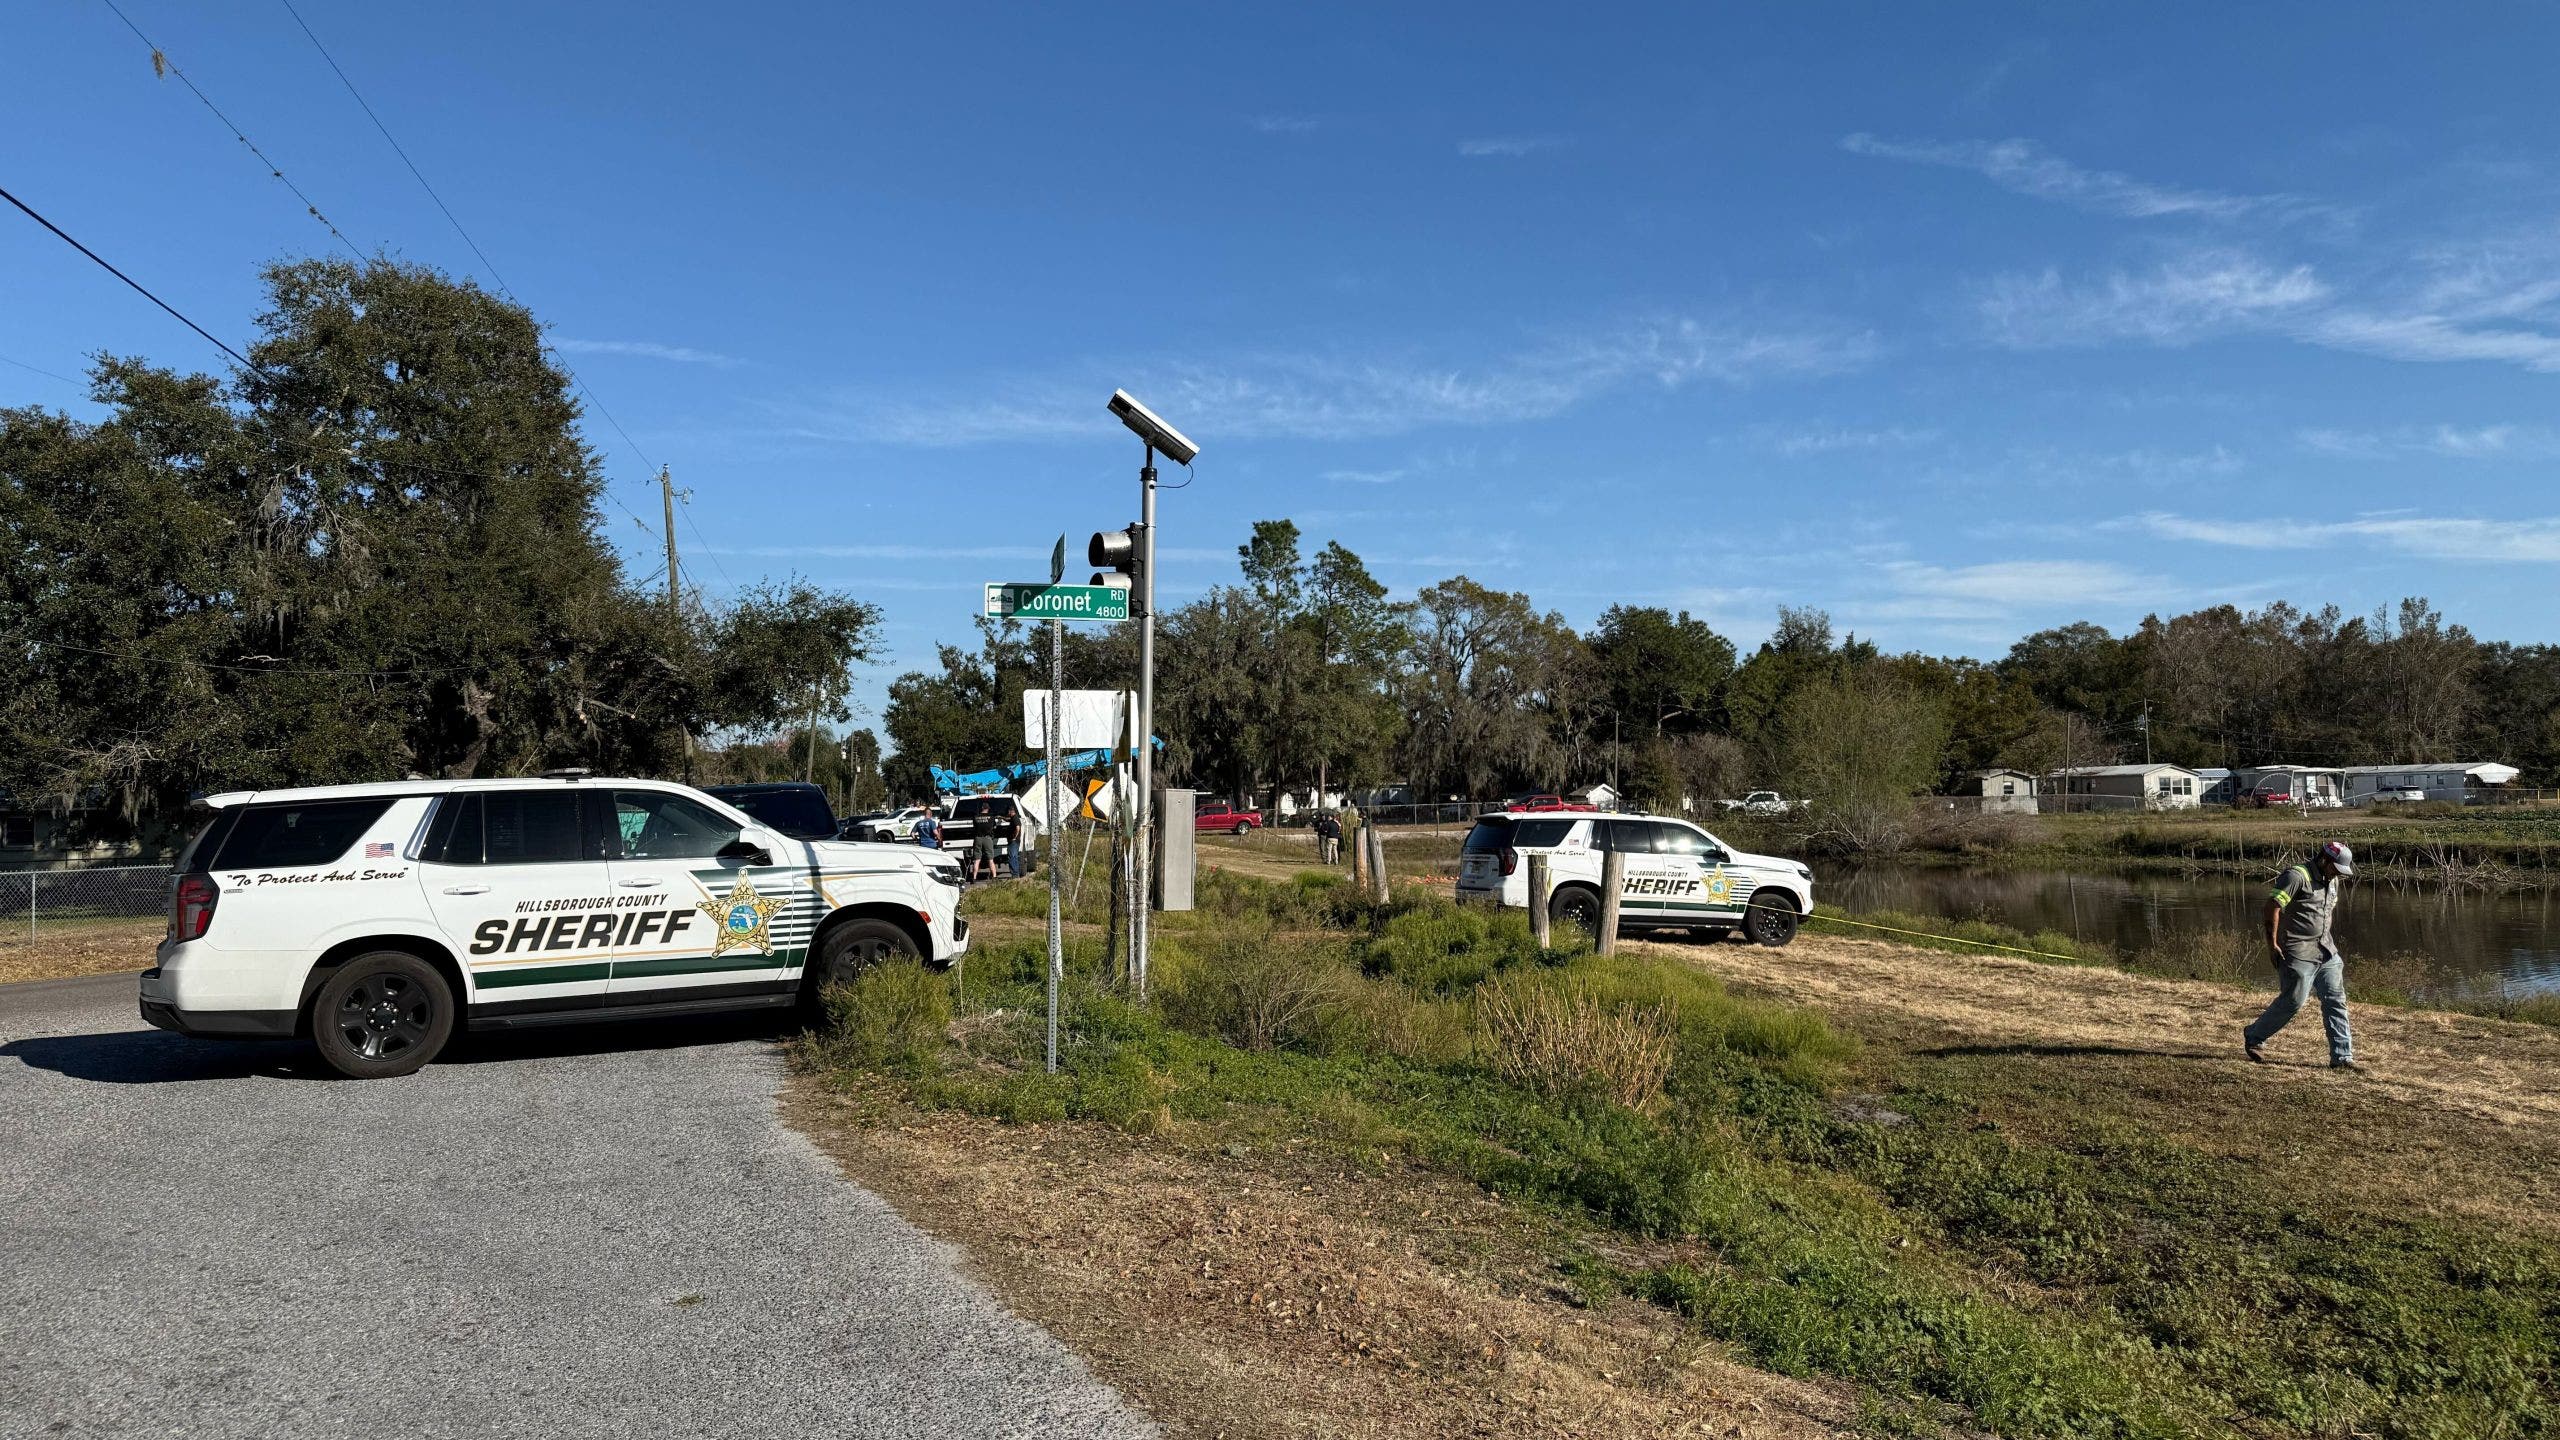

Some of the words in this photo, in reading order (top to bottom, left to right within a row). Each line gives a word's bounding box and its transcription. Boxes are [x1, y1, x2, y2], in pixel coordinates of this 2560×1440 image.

[1021, 589, 1092, 612] Coronet
[1110, 590, 1125, 601] RD
[1096, 606, 1125, 618] 4800
[227, 873, 252, 888] "To
[257, 872, 318, 887] Protect
[320, 869, 357, 883] And
[360, 867, 409, 882] Serve"
[515, 896, 613, 914] HILLSBOROUGH
[616, 893, 669, 908] COUNTY
[469, 908, 697, 955] SHERIFF
